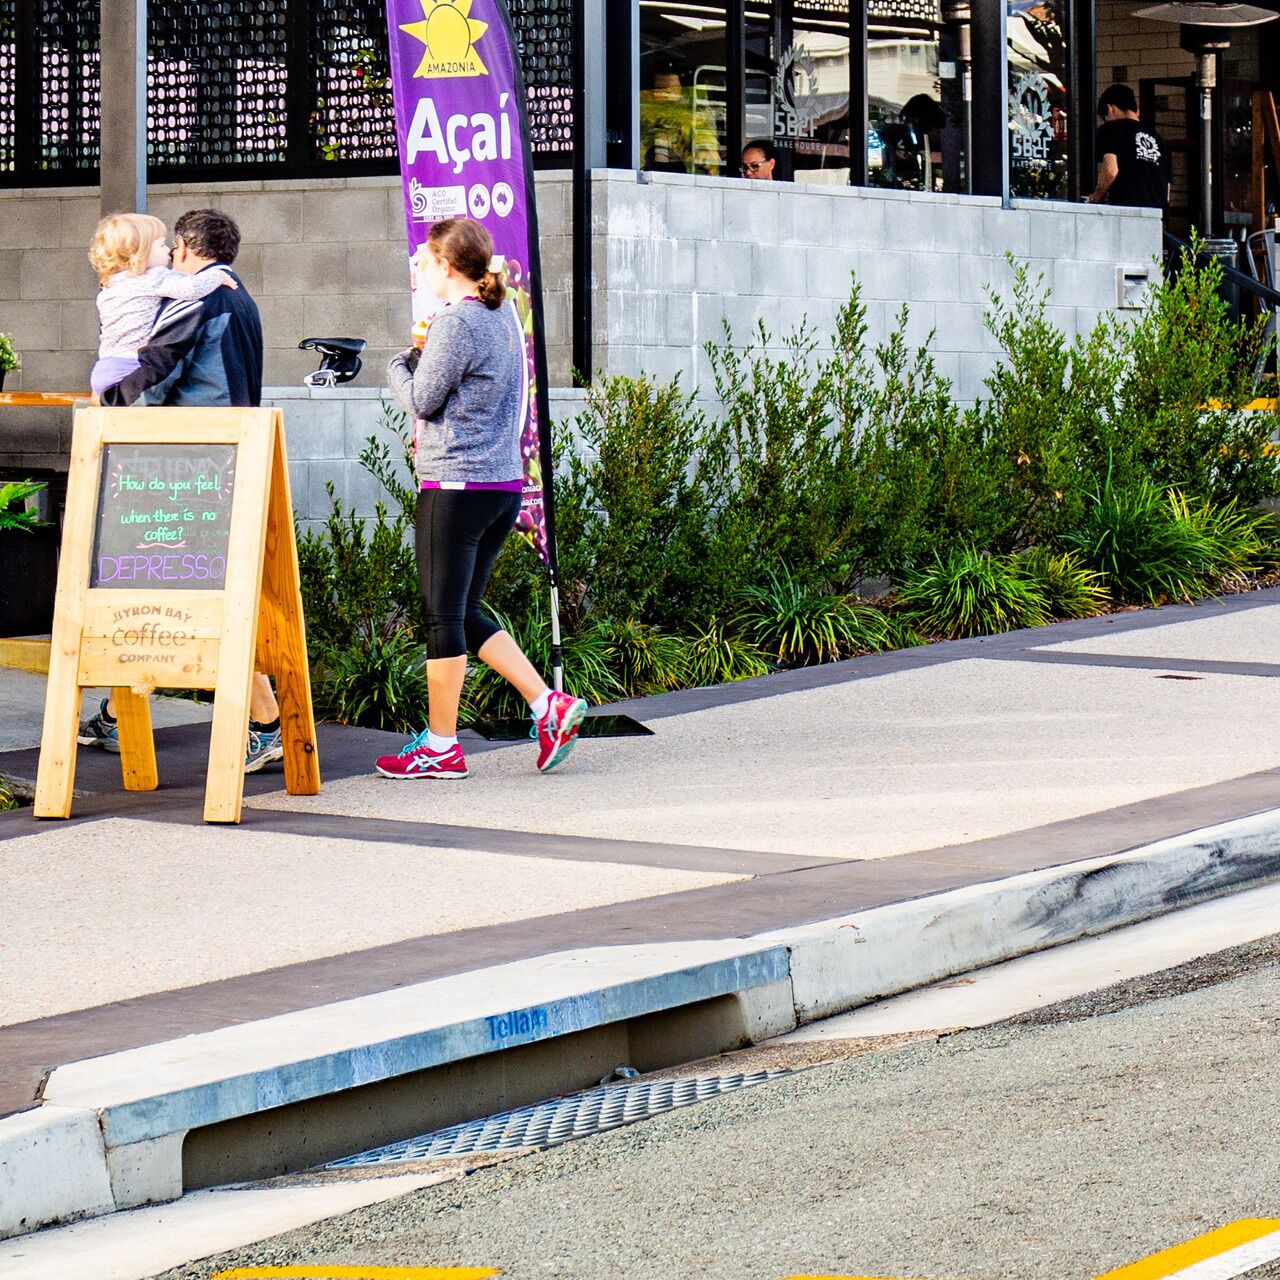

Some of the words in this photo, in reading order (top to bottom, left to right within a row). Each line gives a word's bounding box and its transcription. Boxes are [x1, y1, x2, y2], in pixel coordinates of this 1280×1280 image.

[427, 61, 476, 74] AMAZONIA
[406, 92, 511, 174] Açaí
[773, 140, 821, 151] BAKEHOUSE
[432, 190, 447, 198] ACO
[119, 475, 145, 491] How
[149, 477, 165, 490] do
[168, 481, 191, 501] you
[194, 474, 221, 496] feel
[120, 509, 151, 524] when
[153, 509, 179, 523] there
[183, 508, 194, 521] is
[202, 511, 216, 521] no
[144, 526, 184, 542] coffee?
[98, 554, 226, 583] DEPRESSO
[112, 605, 162, 624] BYRON
[165, 607, 193, 623] BAY
[111, 622, 187, 648] coffee
[119, 653, 176, 664] COMPANY
